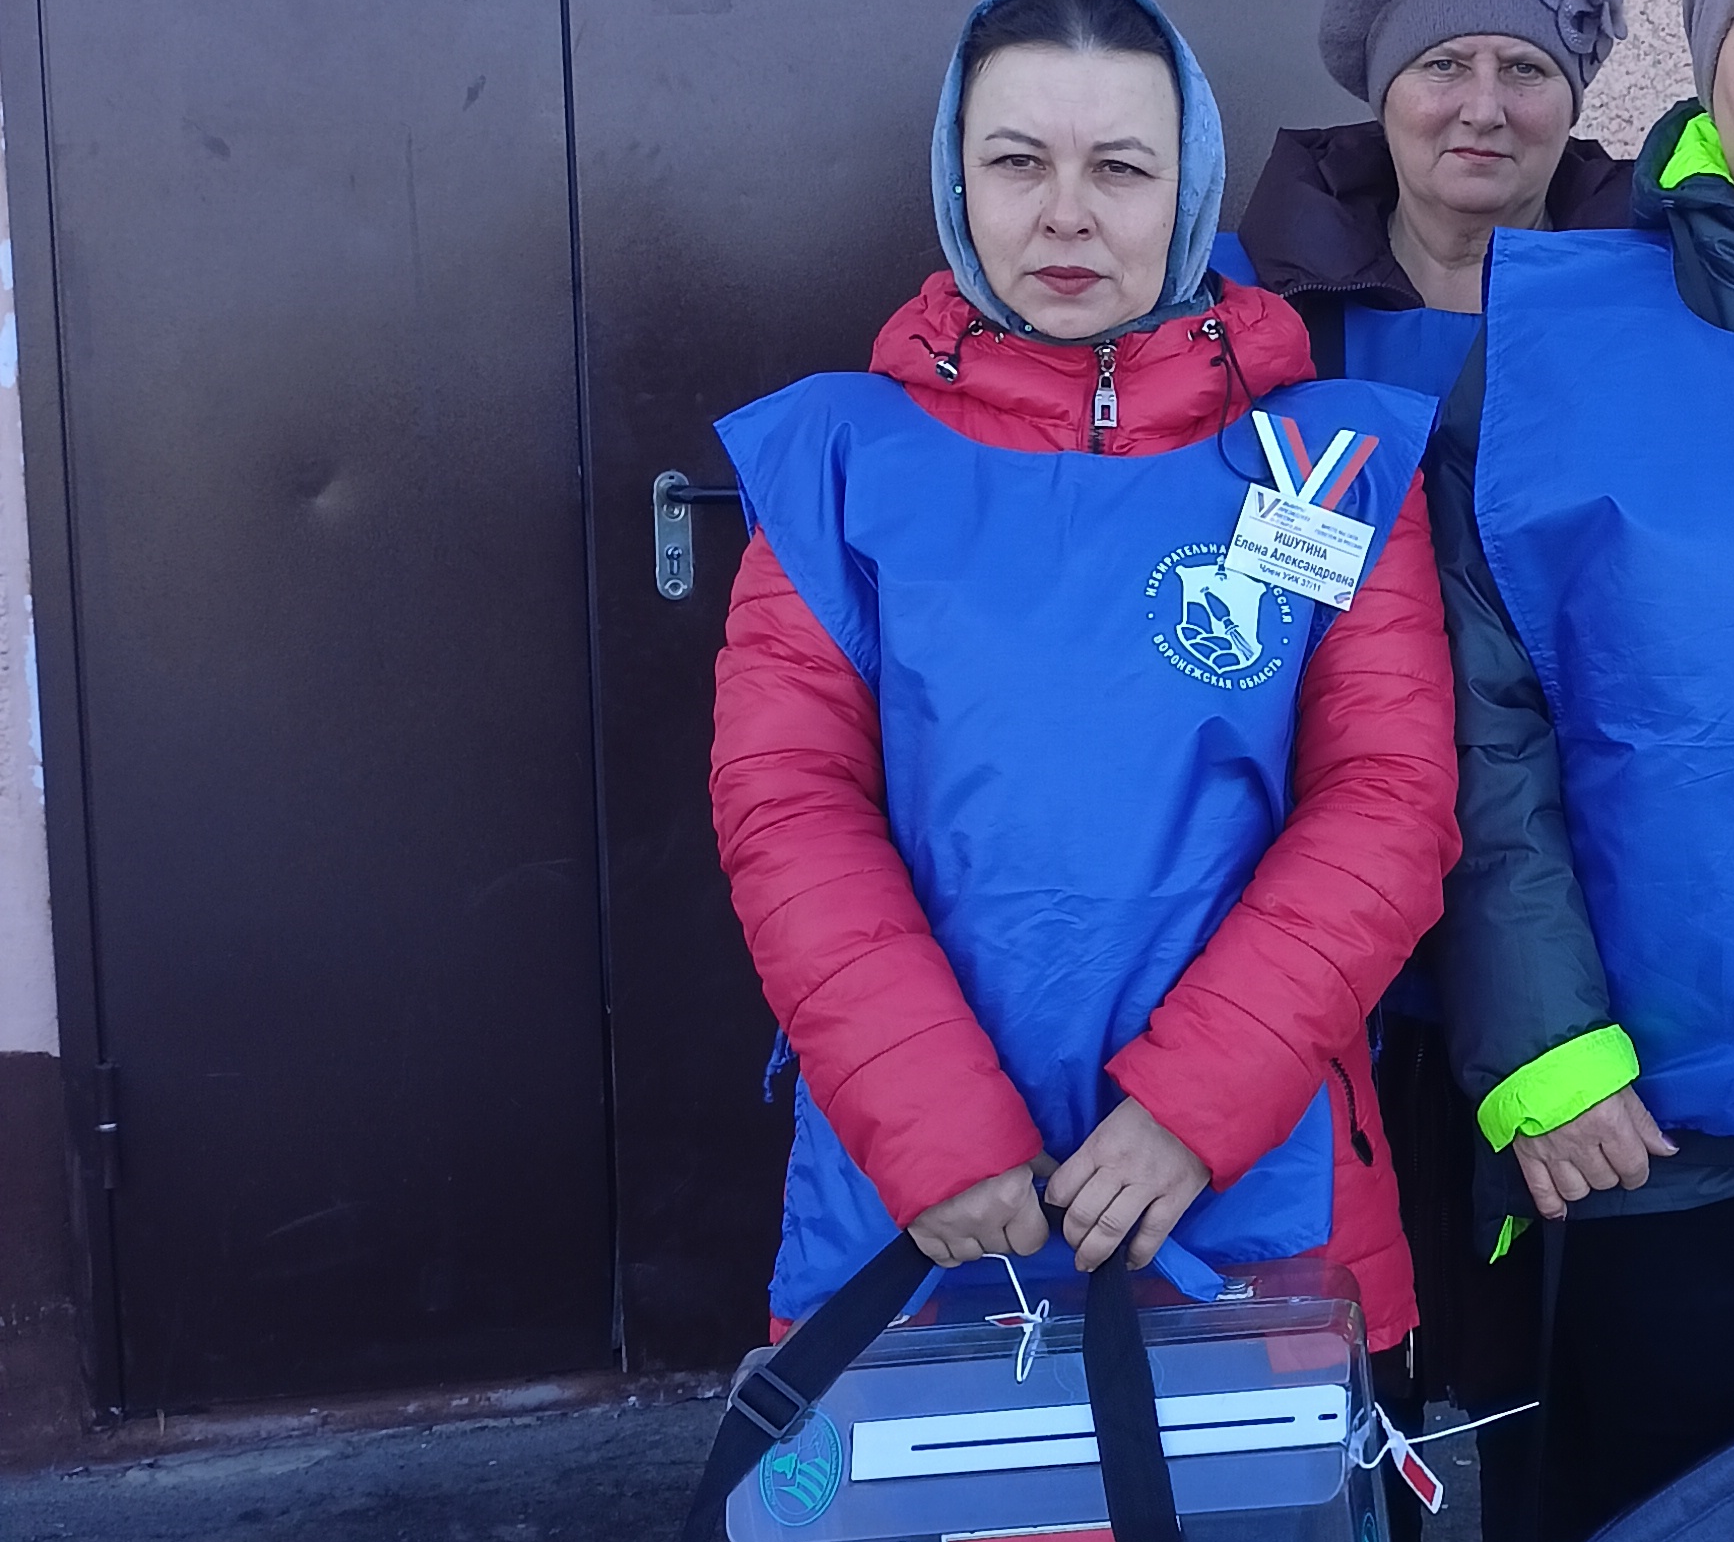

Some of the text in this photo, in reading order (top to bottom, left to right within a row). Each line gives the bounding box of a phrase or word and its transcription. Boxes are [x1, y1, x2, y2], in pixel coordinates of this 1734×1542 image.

[1145, 543, 1227, 597] ИЗБИРАТЕЛЬНА
[1234, 534, 1355, 588] Елена Александровна
[1273, 530, 1328, 560] ИШУТИНА
[1153, 634, 1282, 690] ВОРОНЕЖСКАЯ ОБЛАСТЬ
